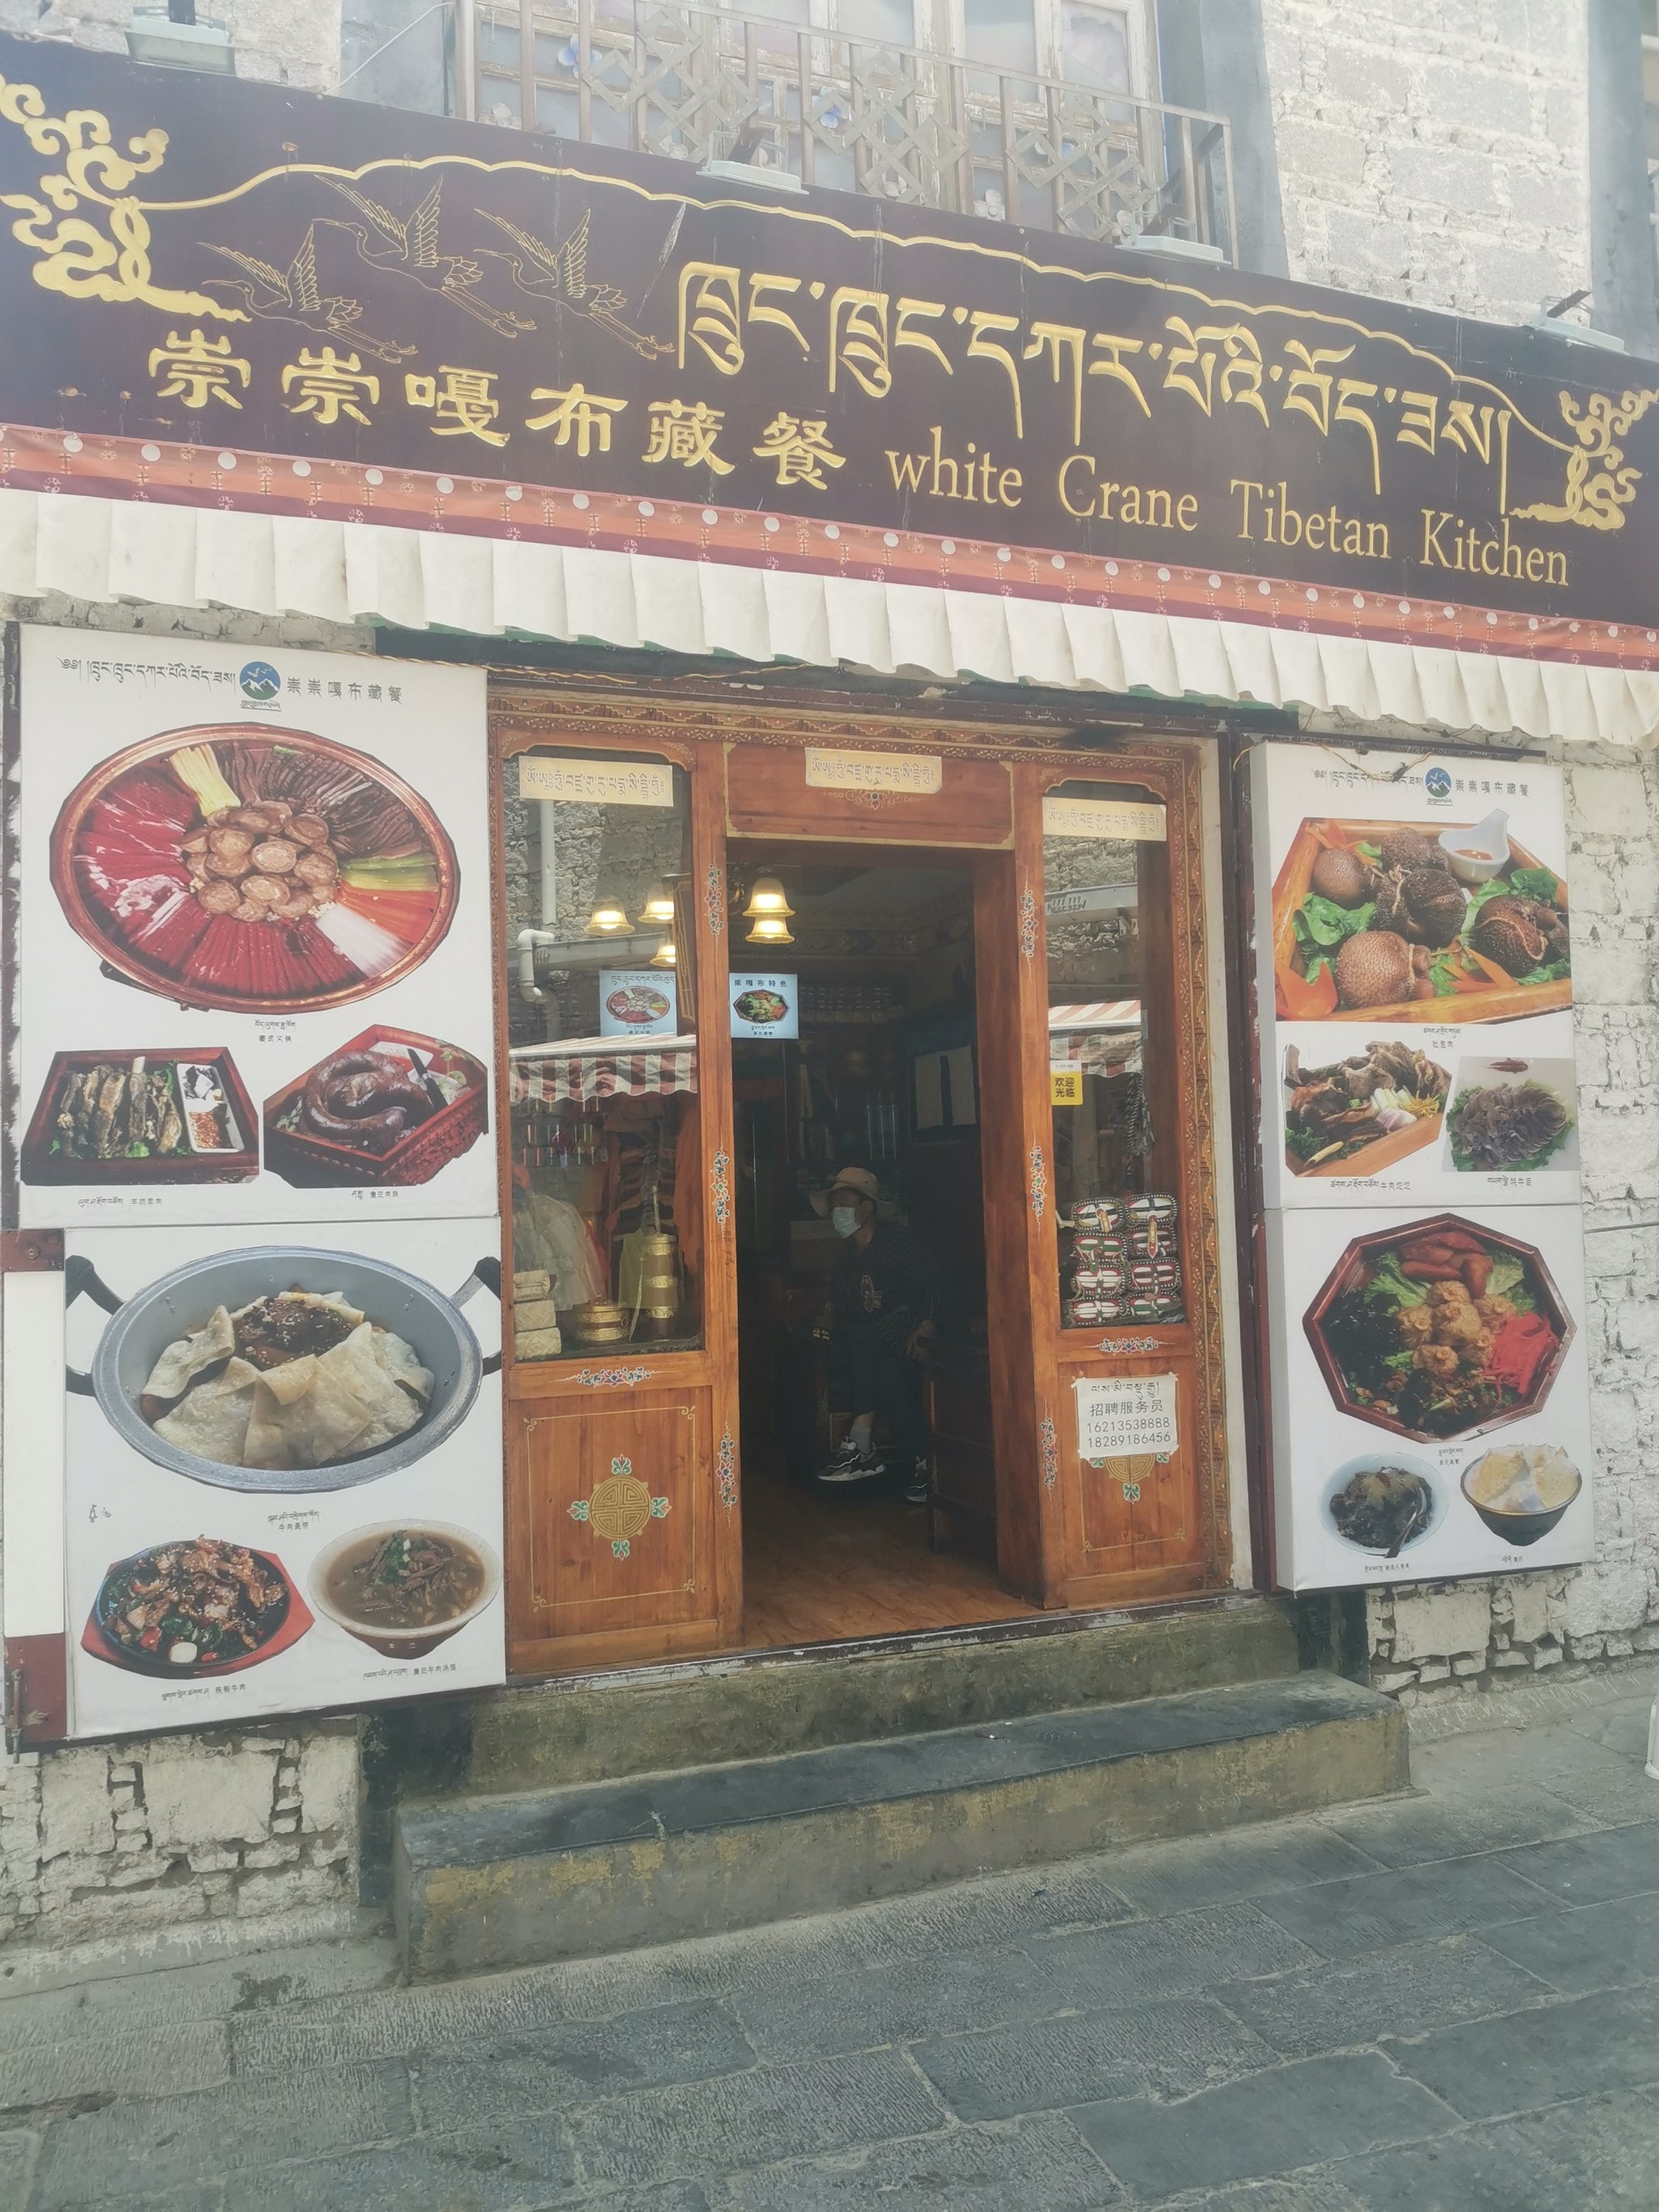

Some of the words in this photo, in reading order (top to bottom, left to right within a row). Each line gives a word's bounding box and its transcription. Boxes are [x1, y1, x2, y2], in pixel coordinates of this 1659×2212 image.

[148, 329, 847, 490] 崇崇嘎布藏餐
[885, 426, 1023, 509] white
[1058, 454, 1199, 533] Crane
[1230, 479, 1392, 560] Tibetan
[1419, 509, 1570, 586] Kitchen
[287, 676, 403, 705] 崇崇嘎布藏餐
[1455, 778, 1529, 798] 崇崇嘎布藏餐
[1055, 1077, 1075, 1087] 欢迎
[1056, 1088, 1075, 1097] 光临
[1090, 1399, 1164, 1417] 招聘服务员
[1087, 1417, 1171, 1434] 16213538888
[1088, 1432, 1171, 1448] 18289186456
